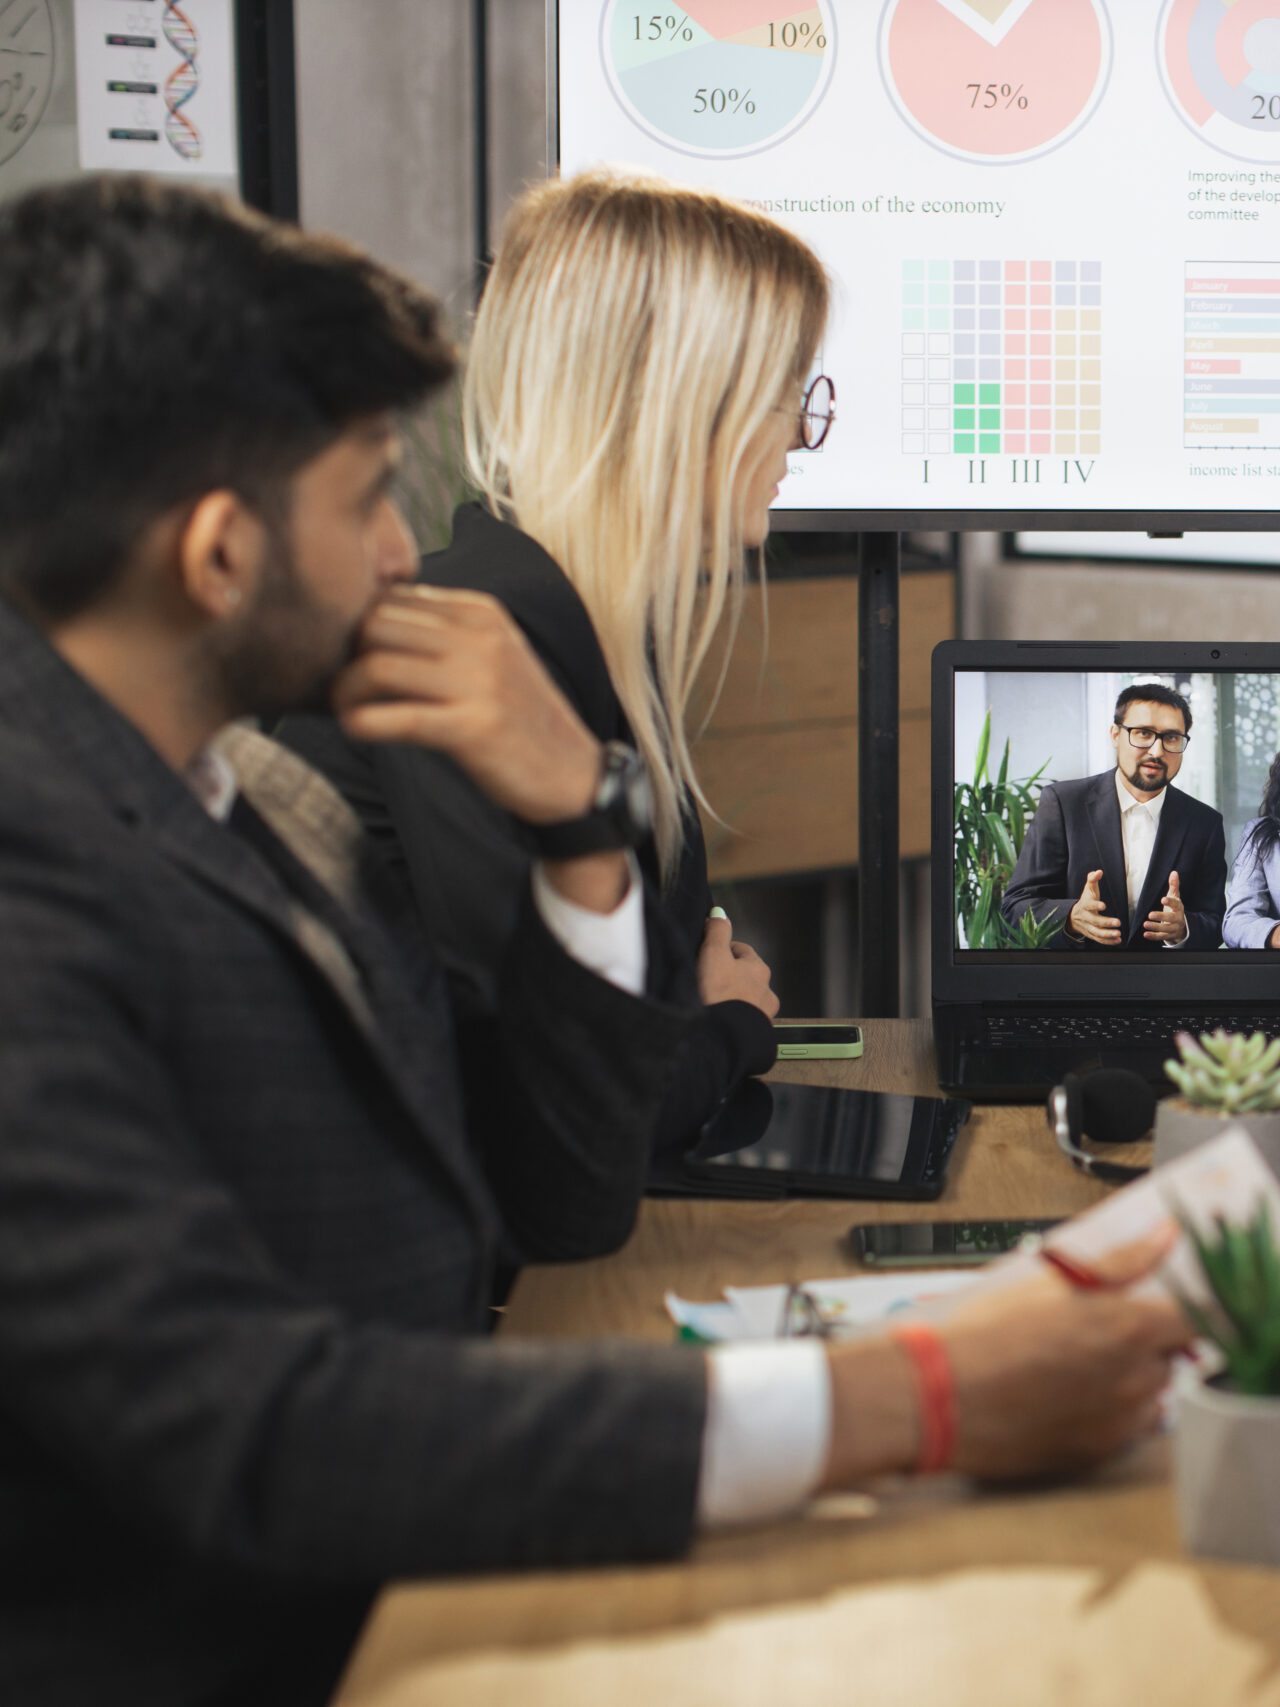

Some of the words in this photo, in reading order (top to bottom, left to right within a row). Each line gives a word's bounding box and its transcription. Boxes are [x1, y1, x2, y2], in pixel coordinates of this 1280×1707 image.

[633, 16, 693, 42] 15%
[767, 22, 827, 48] 10%
[693, 88, 756, 114] 50%
[966, 83, 1029, 110] 75%
[1188, 170, 1256, 186] Improving
[1260, 171, 1280, 183] the
[1188, 188, 1202, 201] of
[1205, 189, 1226, 202] the
[862, 195, 884, 213] of
[888, 195, 915, 213] the
[921, 201, 1005, 217] economy
[1187, 208, 1260, 221] committee
[1190, 280, 1229, 292] January
[1190, 300, 1233, 312] February
[1190, 360, 1211, 372] May
[1190, 380, 1213, 392] June
[1190, 420, 1224, 432] August
[922, 459, 930, 483] I
[968, 459, 987, 483] II
[1011, 459, 1041, 483] III
[1063, 460, 1096, 483] IV
[1189, 463, 1238, 477] income
[1242, 463, 1262, 477] list
